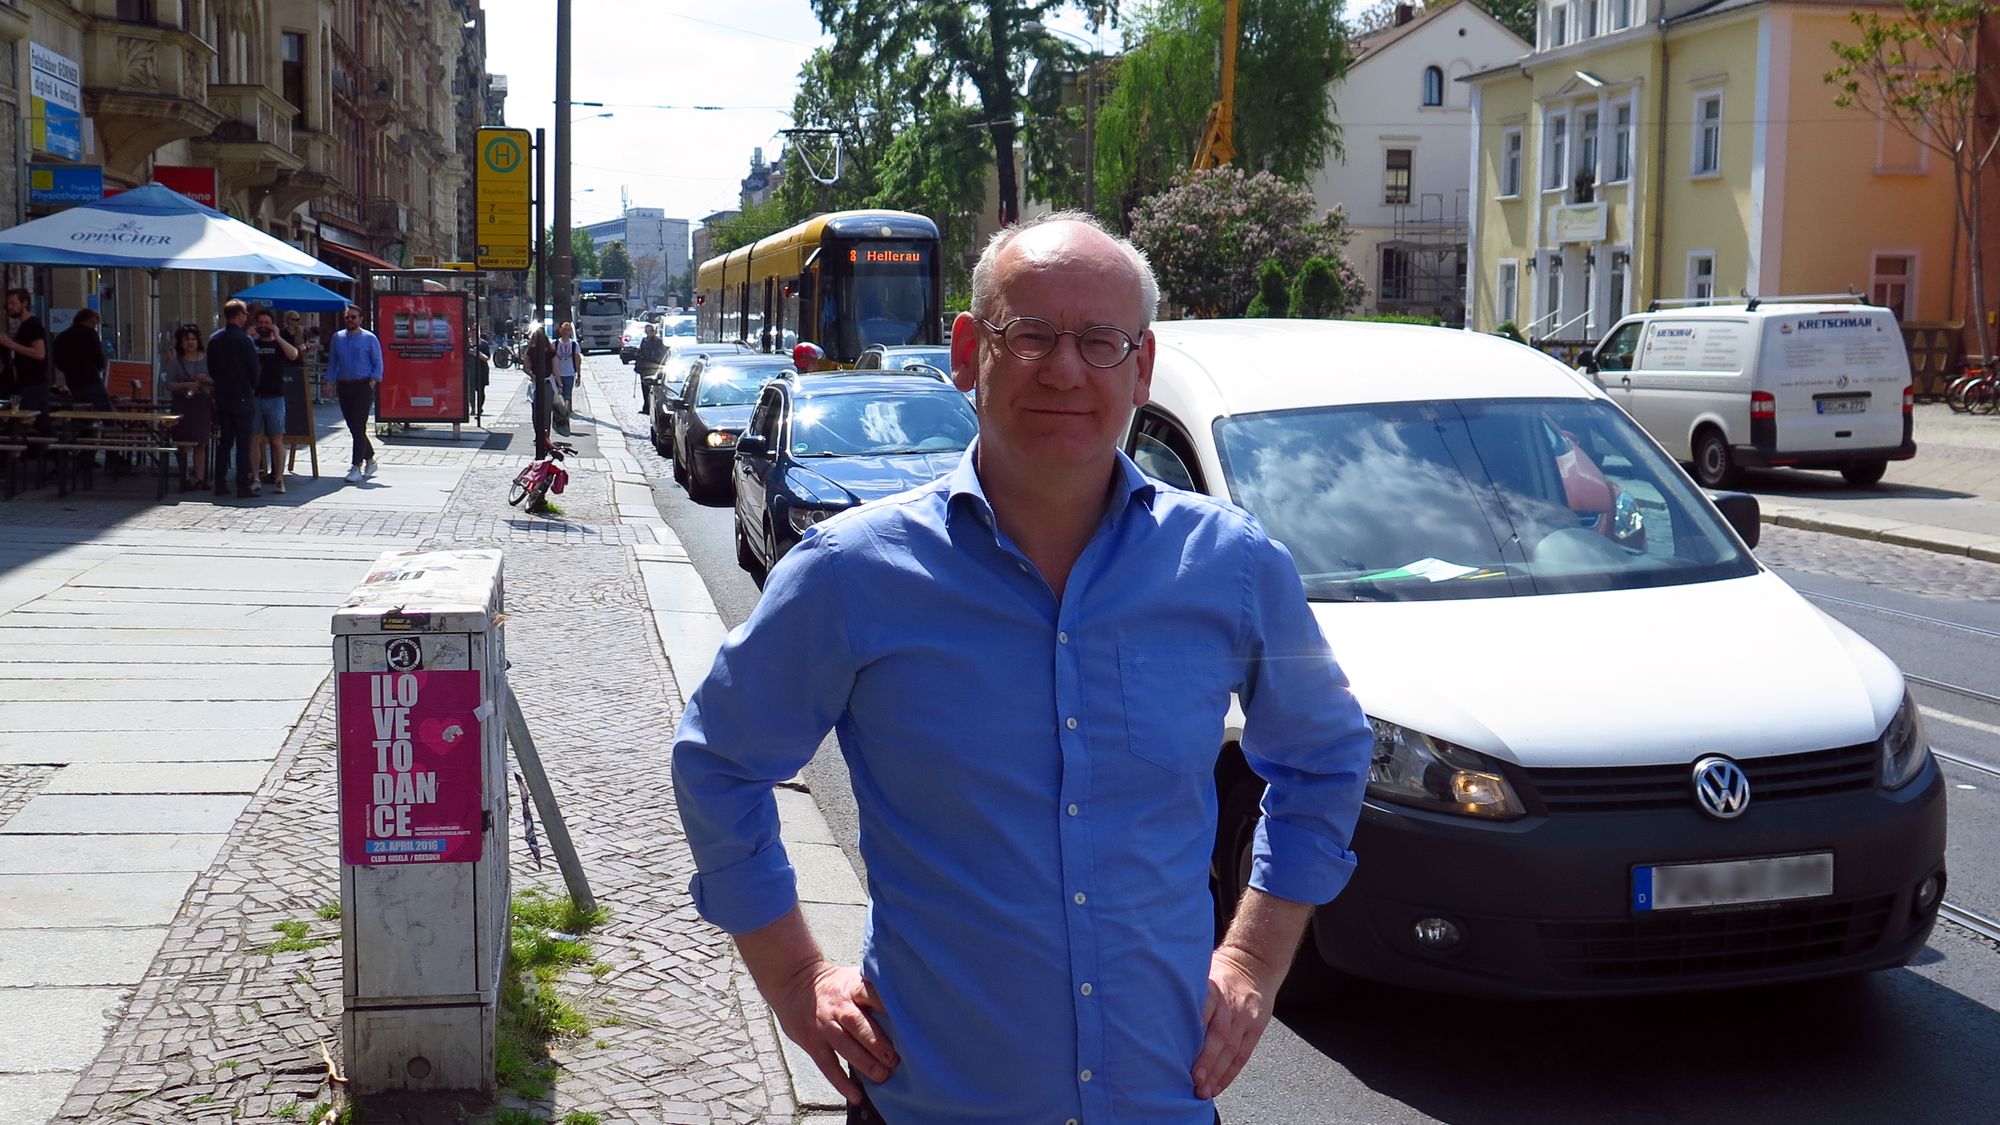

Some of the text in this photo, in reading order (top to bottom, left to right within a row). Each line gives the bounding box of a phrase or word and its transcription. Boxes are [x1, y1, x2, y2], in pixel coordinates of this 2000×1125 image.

[34, 75, 53, 96] digital
[54, 83, 59, 98] &
[31, 190, 102, 203] Physiotherapie
[488, 203, 496, 213] 7
[488, 214, 496, 224] 8
[70, 231, 172, 245] OPPACHER
[849, 249, 921, 262] 8 Hellerau
[1797, 317, 1873, 331] KRETSCHMAR
[371, 674, 418, 708] ILO
[372, 706, 411, 740] VE
[373, 739, 414, 773] TO
[373, 772, 437, 805] DAN
[374, 804, 413, 838] CE
[373, 840, 439, 852] 23. APRIL 2016
[387, 854, 409, 862] GISELA
[1638, 893, 1646, 903] D
